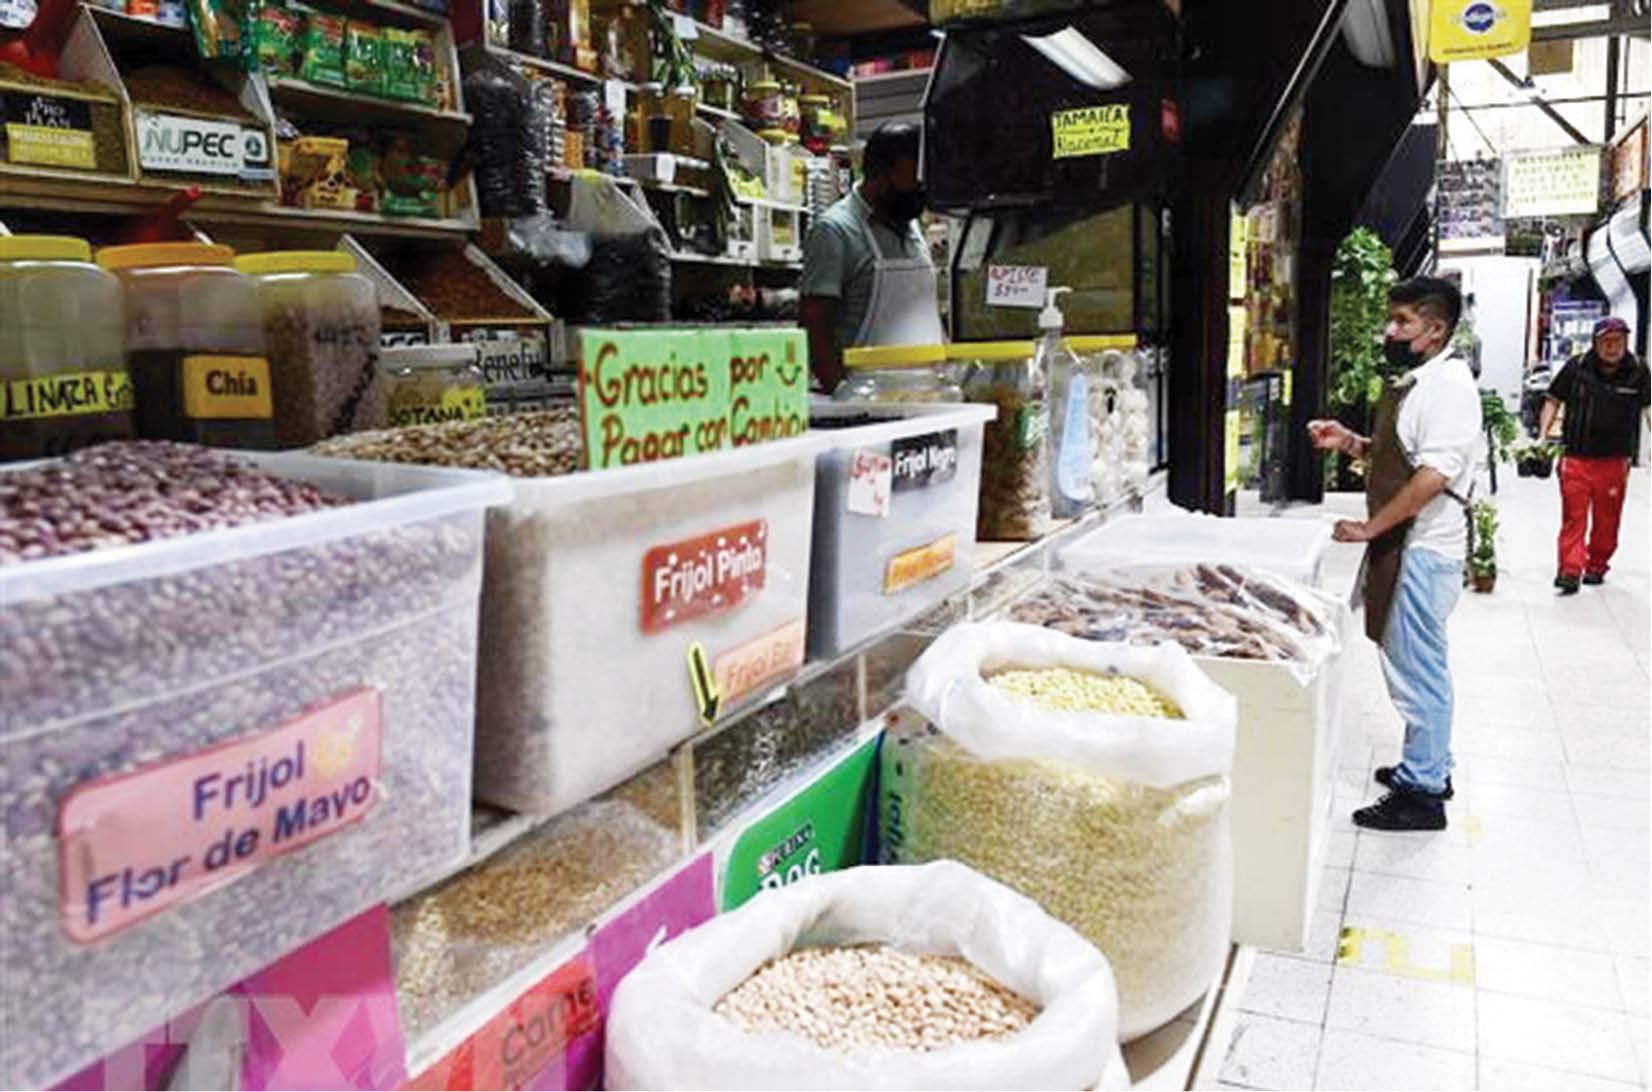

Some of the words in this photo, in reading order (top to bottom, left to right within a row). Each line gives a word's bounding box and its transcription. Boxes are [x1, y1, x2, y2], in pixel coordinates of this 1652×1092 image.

[594, 341, 708, 407] Gracias
[729, 353, 770, 396] por
[655, 550, 713, 604] Frijol
[717, 542, 762, 585] Pinto
[193, 740, 304, 822] Frijol
[85, 855, 190, 925] Flor
[203, 828, 260, 872] de
[273, 775, 371, 844] Mayo
